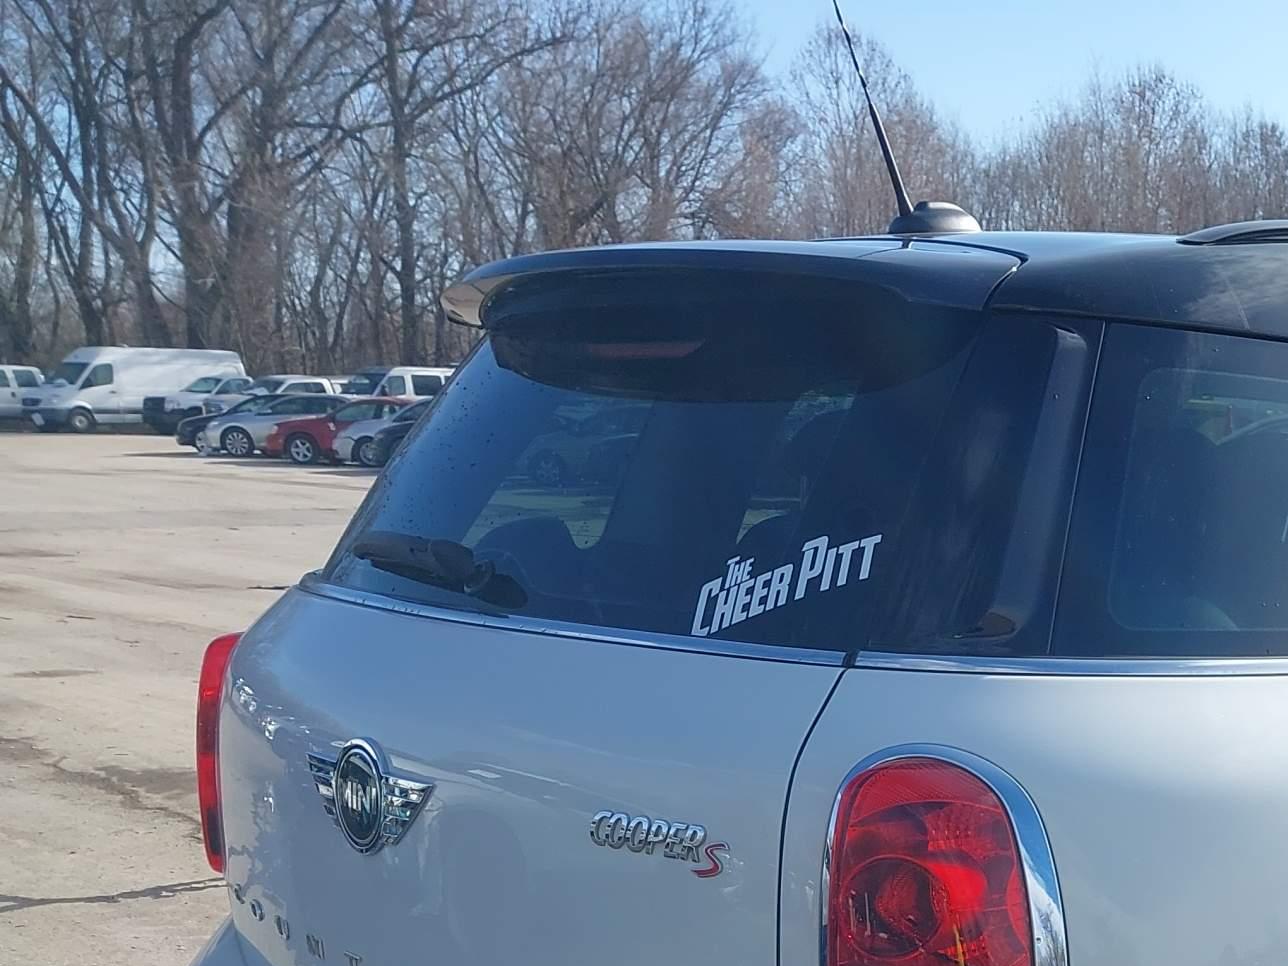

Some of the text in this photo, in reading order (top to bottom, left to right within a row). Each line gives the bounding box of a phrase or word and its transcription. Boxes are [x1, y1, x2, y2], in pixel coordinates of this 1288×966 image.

[690, 534, 883, 637] CHEER PITT
[726, 555, 755, 588] THE
[341, 780, 377, 815] MINI
[590, 809, 730, 878] COOPER S
